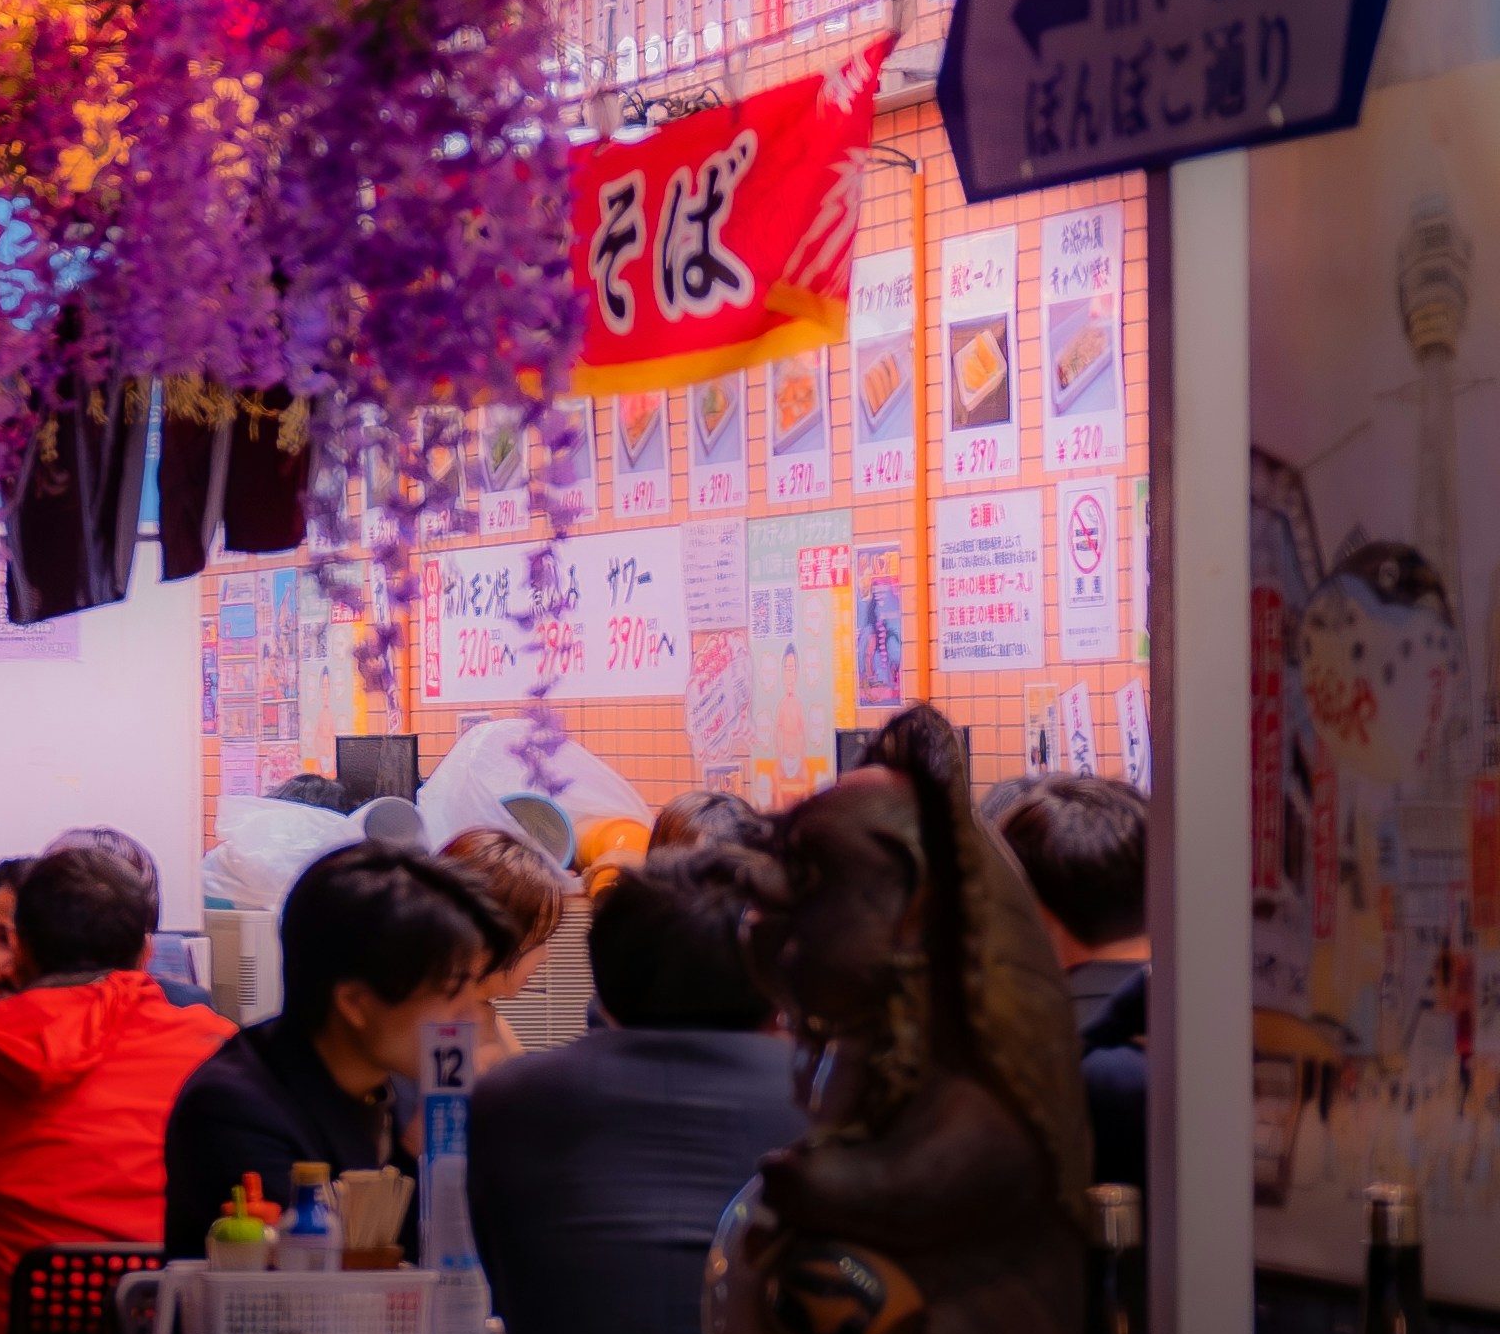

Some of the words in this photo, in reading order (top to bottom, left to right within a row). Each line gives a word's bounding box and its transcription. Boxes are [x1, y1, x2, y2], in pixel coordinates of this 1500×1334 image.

[592, 126, 755, 331] そば
[799, 545, 850, 589] 営業中
[434, 1047, 464, 1088] 12
